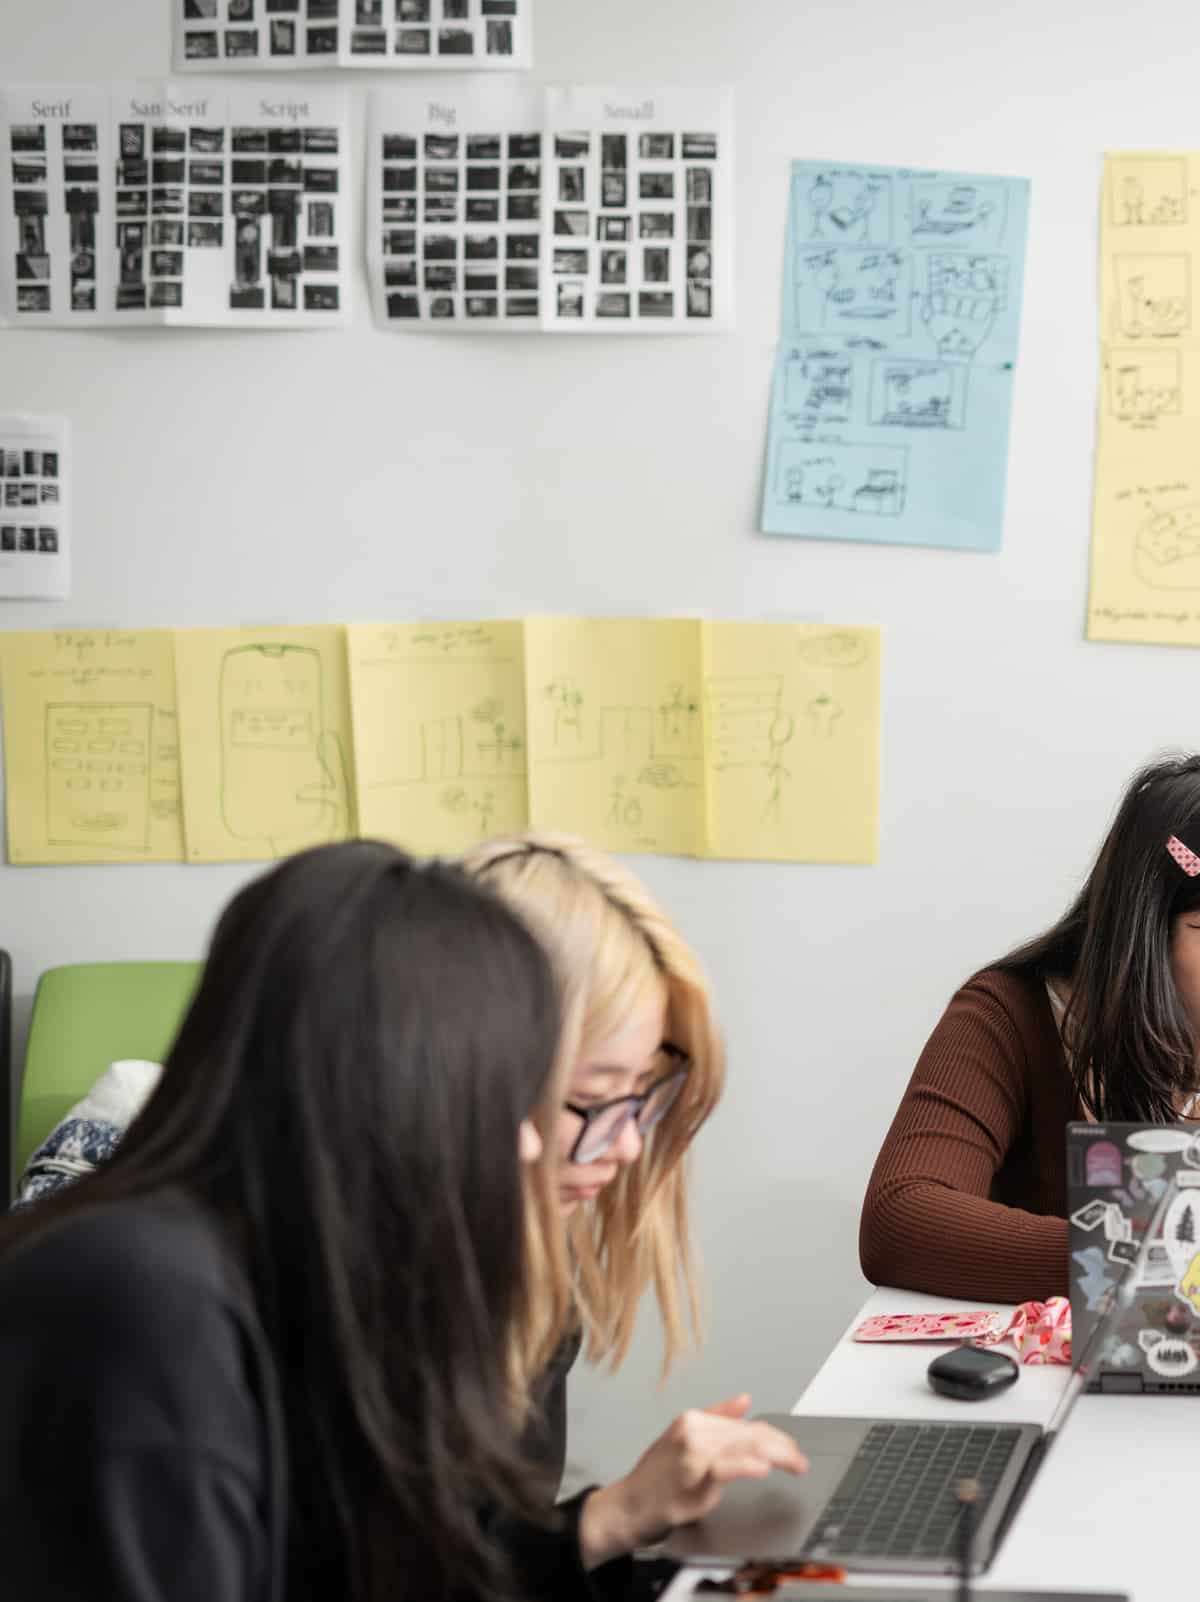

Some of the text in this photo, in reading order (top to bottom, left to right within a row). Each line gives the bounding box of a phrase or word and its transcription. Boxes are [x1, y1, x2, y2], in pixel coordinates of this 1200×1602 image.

[31, 99, 72, 119] Serif
[167, 99, 208, 118] Serif
[258, 99, 310, 121] Script
[428, 102, 457, 126] Big
[603, 100, 655, 121] Small
